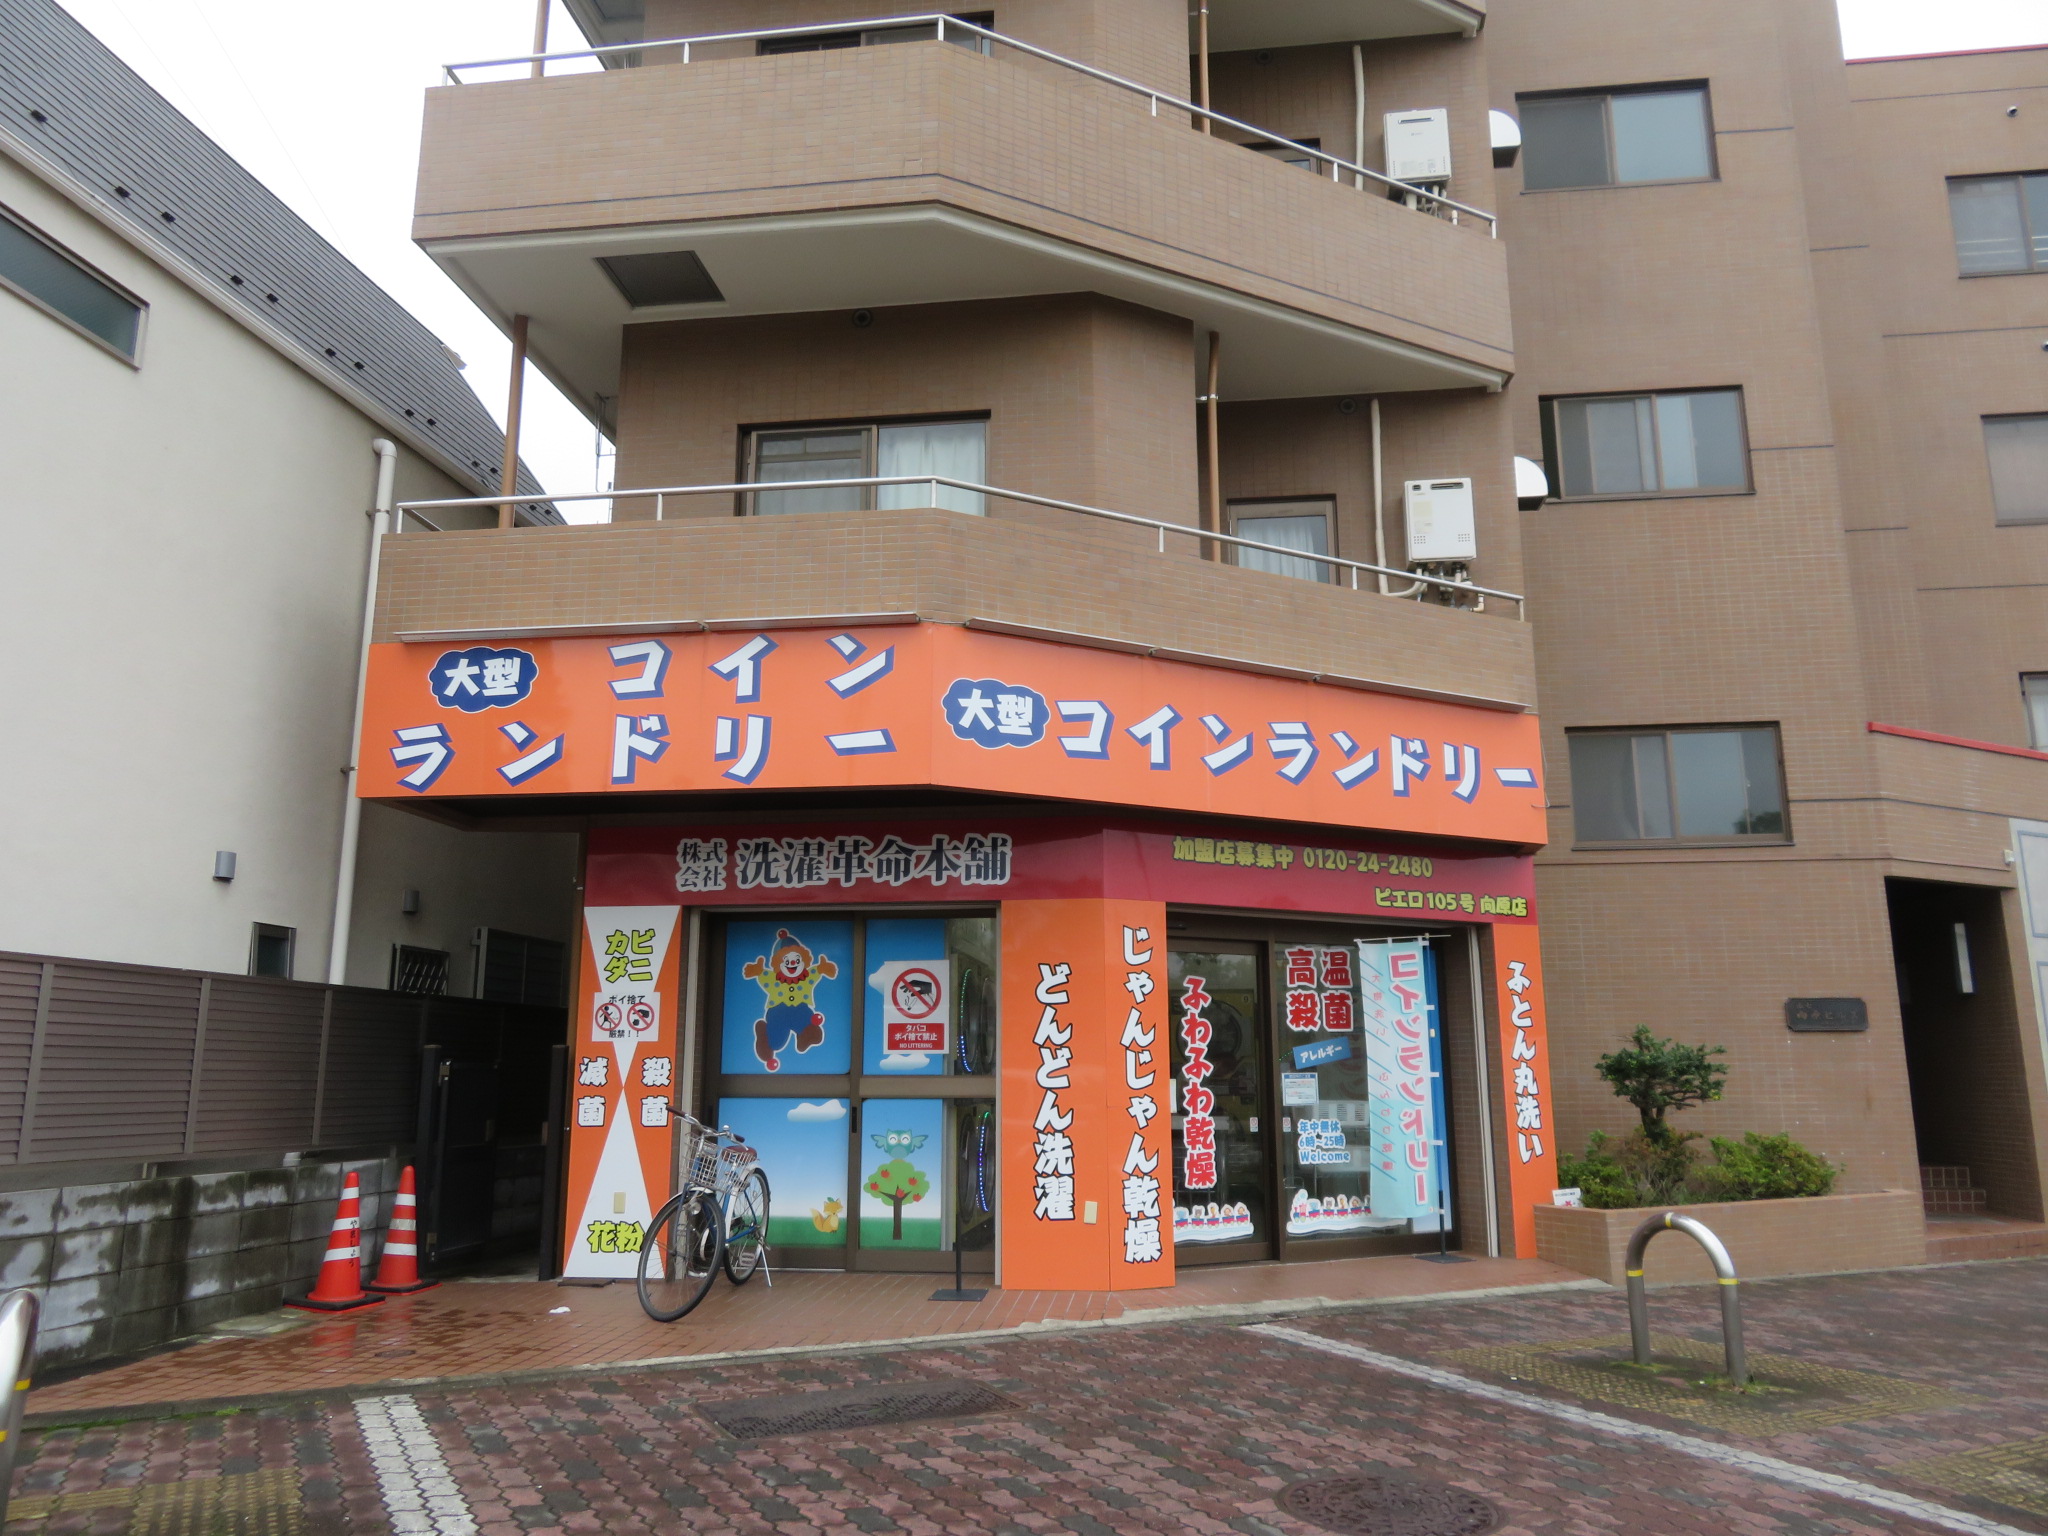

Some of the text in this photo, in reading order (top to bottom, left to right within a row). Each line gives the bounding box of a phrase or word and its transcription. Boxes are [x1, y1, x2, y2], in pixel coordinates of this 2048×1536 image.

[443, 656, 522, 698] 大型
[608, 632, 895, 703] コイン
[957, 688, 1034, 736] 大型
[389, 714, 897, 793] ランドリー
[1055, 700, 1539, 804] コインランドリー
[738, 836, 1011, 888] 洗濯革命本舗
[1173, 836, 1433, 878] 加盟店募集中 0120-24-2480
[1480, 895, 1528, 917] 向原店
[604, 928, 655, 955] カビ
[604, 956, 654, 983] ダニ
[1285, 946, 1352, 988] 高温
[905, 1024, 927, 1032] タバコ
[1285, 990, 1354, 1034] 殺菌
[1299, 1044, 1343, 1064] アレルギー
[1505, 960, 1544, 1165] ふとん丸洗い
[577, 1056, 609, 1128] 滅菌
[640, 1056, 673, 1128] 殺菌
[1032, 962, 1077, 1222] どんどん洗濯
[1120, 924, 1163, 1264] じゃんじゃん乾燥
[1179, 974, 1218, 1190] ふわふわ乾燥
[1299, 1119, 1341, 1134] 年中無休
[1300, 1150, 1350, 1162] Welcome
[587, 1220, 646, 1254] 花粉
